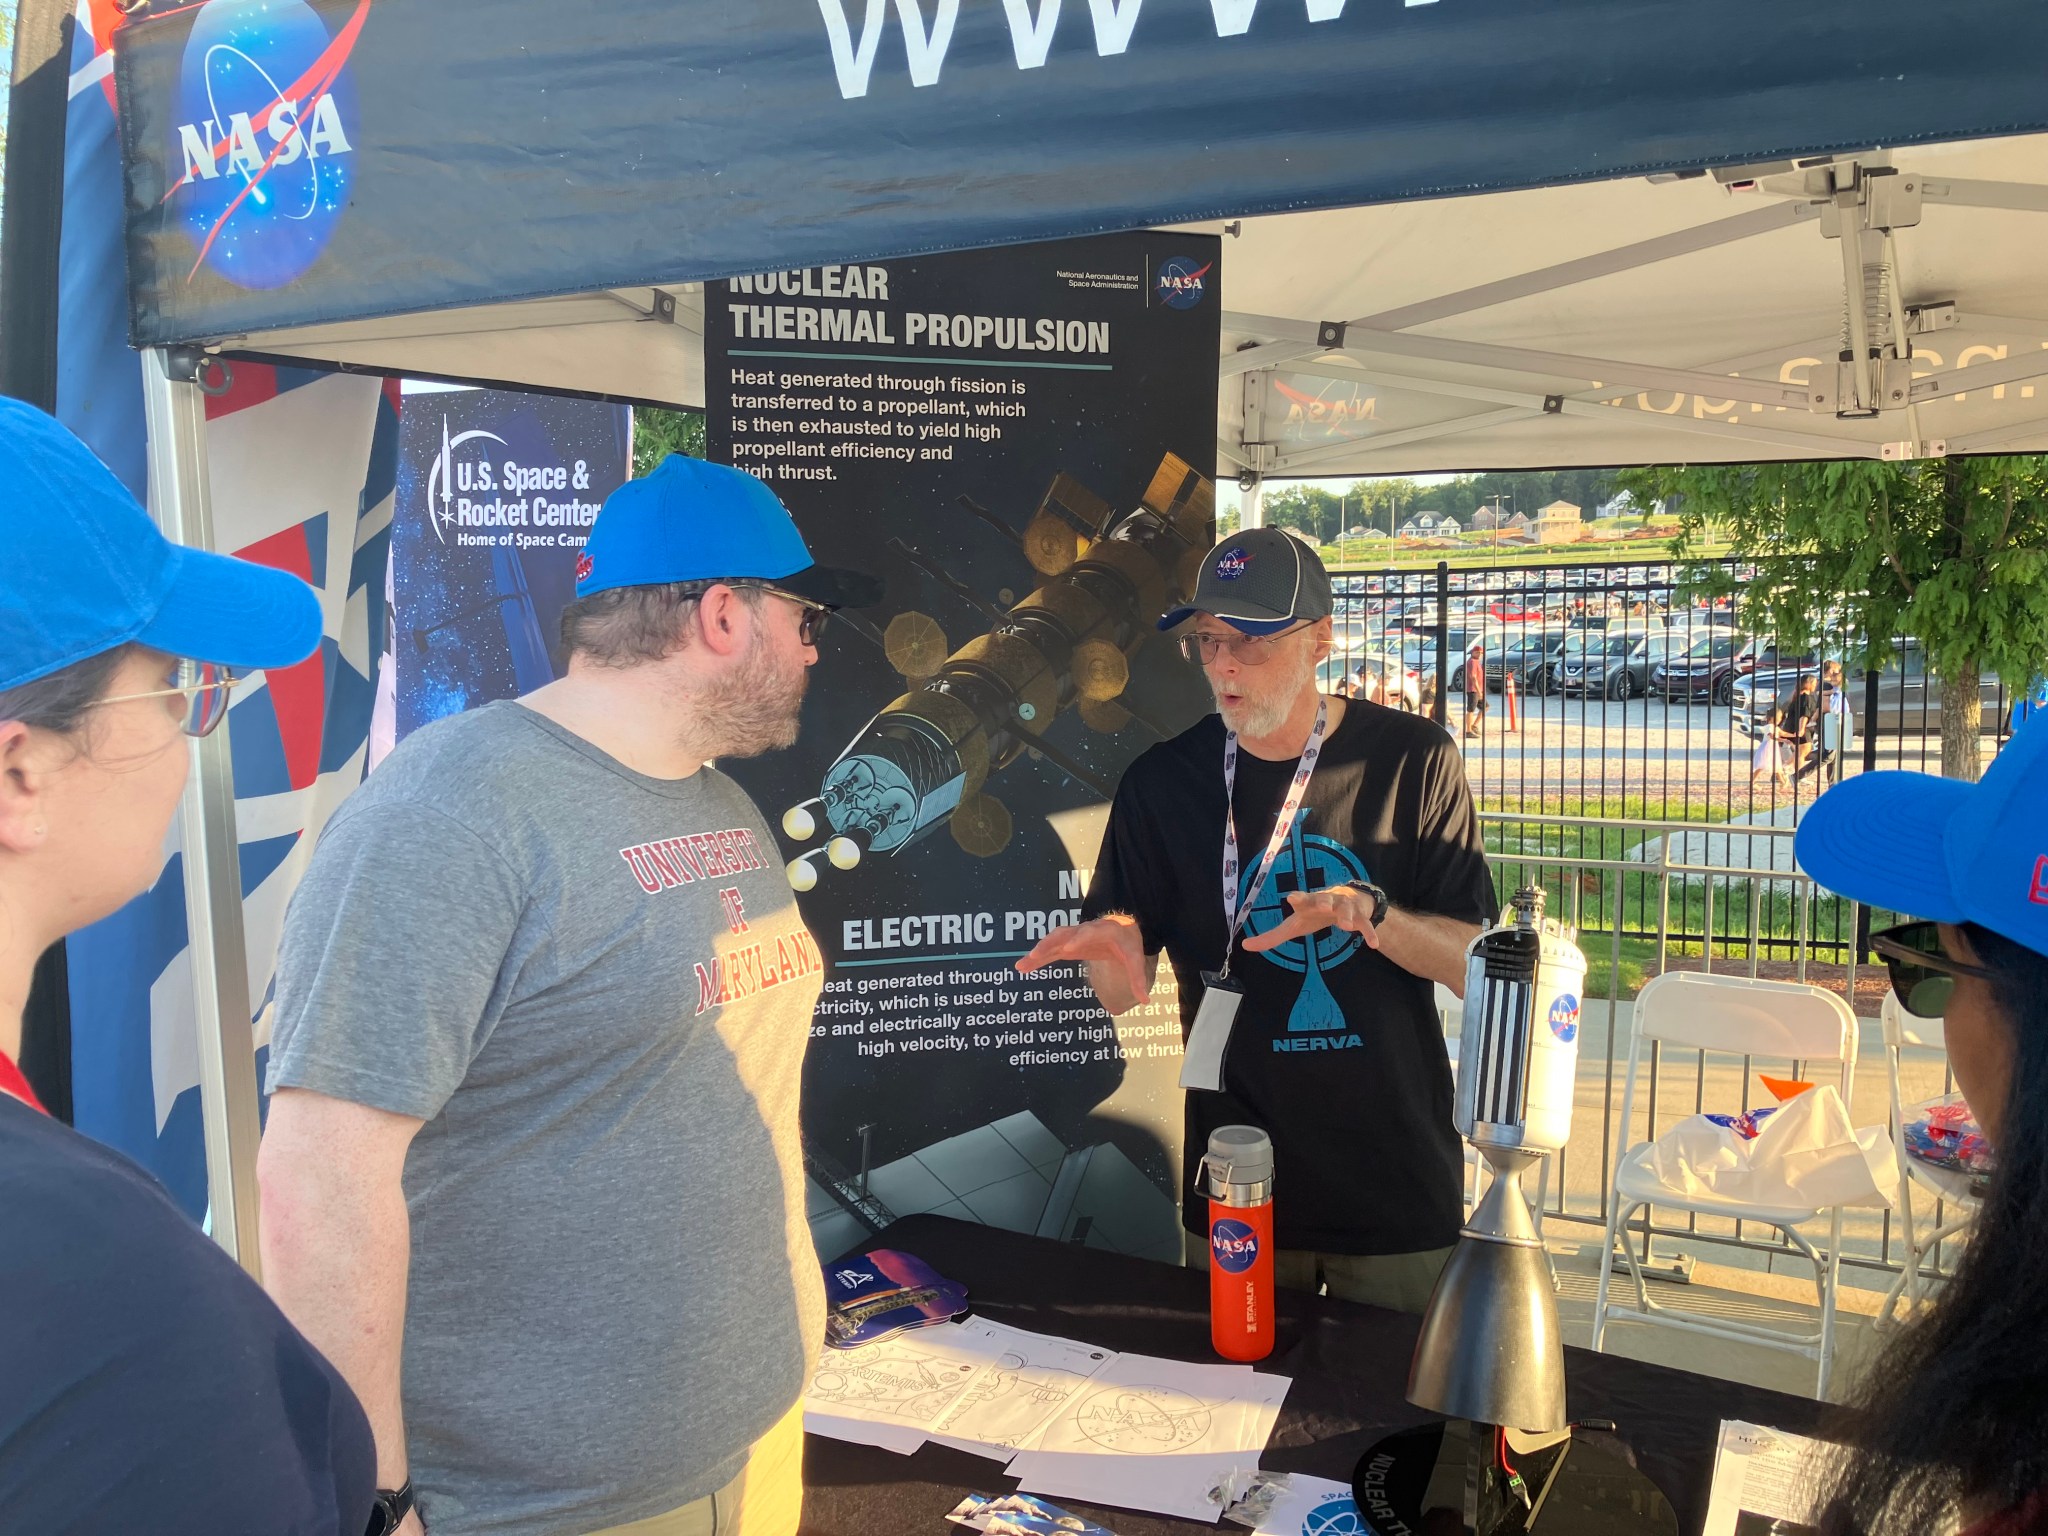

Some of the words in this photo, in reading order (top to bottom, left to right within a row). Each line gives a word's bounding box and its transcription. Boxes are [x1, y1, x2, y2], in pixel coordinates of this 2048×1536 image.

[177, 93, 353, 185] NASA
[730, 265, 889, 300] NUCLEAR
[1056, 270, 1085, 279] National
[1085, 272, 1125, 281] Aeronautics
[1126, 275, 1139, 283] and
[1069, 280, 1090, 288] Space
[1091, 281, 1139, 290] Administration
[1161, 276, 1203, 289] NASA
[728, 303, 895, 345] THERMAL
[906, 312, 1110, 354] PROPULSION
[731, 368, 776, 387] Heat
[780, 372, 873, 393] generated
[877, 375, 946, 395] through
[950, 377, 1007, 394] fission
[1011, 379, 1026, 395] is
[732, 393, 833, 413] transferred
[839, 397, 858, 413] to
[862, 400, 873, 414] a
[878, 399, 970, 419] propellant,
[975, 400, 1026, 418] which
[732, 417, 748, 432] is
[752, 417, 794, 434] then
[799, 418, 892, 437] exhausted
[897, 421, 915, 437] to
[919, 421, 960, 441] yield
[965, 423, 1001, 442] high
[732, 440, 826, 459] propellant
[830, 442, 916, 463] efficiency
[920, 445, 953, 461] and
[457, 462, 498, 491] U.S.
[503, 461, 567, 496] Space
[572, 460, 590, 490] &
[733, 463, 773, 480] igh
[778, 463, 838, 480] thrust.
[457, 498, 529, 527] Rocket
[533, 497, 602, 527] Center
[457, 533, 497, 546] Home
[499, 533, 514, 546] of
[516, 534, 554, 550] Space
[558, 533, 591, 547] Cam
[1218, 560, 1245, 570] NASA
[843, 911, 994, 951] ELECTRIC
[821, 978, 853, 993] eat
[857, 971, 944, 994] generated
[948, 968, 1014, 985] through
[879, 995, 929, 1011] which
[934, 993, 949, 1007] is
[953, 988, 994, 1006] used
[999, 986, 1018, 1005] by
[1024, 989, 1043, 1001] an
[831, 1020, 864, 1036] and
[869, 1013, 961, 1032] electrically
[966, 1008, 1053, 1027] accelerate
[1144, 1003, 1161, 1016] at
[858, 1041, 895, 1058] high
[899, 1035, 969, 1052] velocity,
[973, 1033, 991, 1048] to
[995, 1030, 1034, 1049] yield
[1038, 1030, 1074, 1044] very
[1078, 1026, 1113, 1043] high
[1009, 1048, 1090, 1065] efficiency
[1093, 1047, 1110, 1060] at
[1114, 1045, 1143, 1059] low
[1272, 1034, 1364, 1052] NERVA
[1213, 1235, 1256, 1252] NASA
[1246, 1281, 1254, 1322] STANLEY
[849, 1366, 926, 1391] ARTEMIS
[1089, 1405, 1200, 1431] NASA
[1364, 1453, 1396, 1519] NUCLEAR
